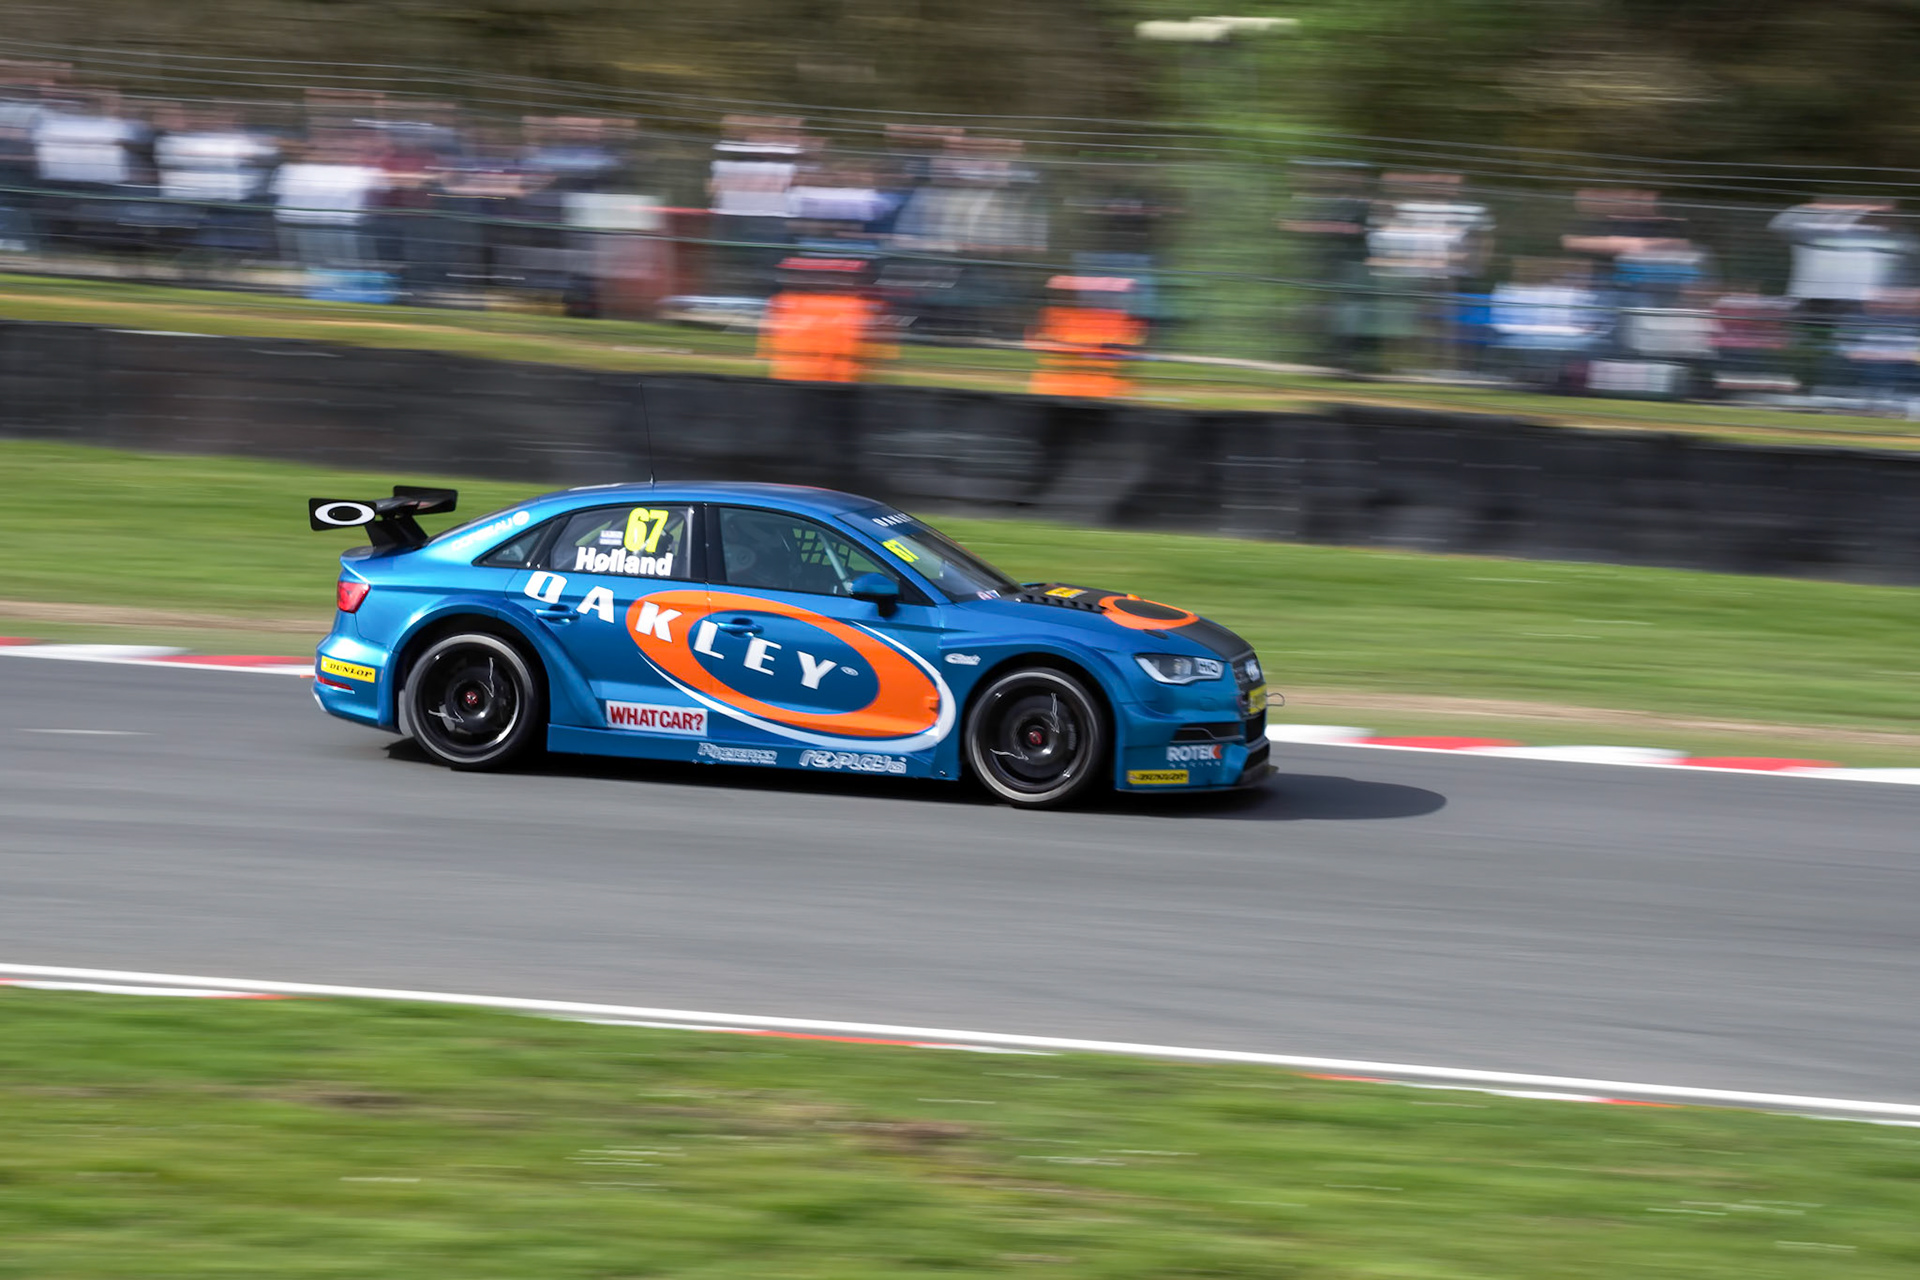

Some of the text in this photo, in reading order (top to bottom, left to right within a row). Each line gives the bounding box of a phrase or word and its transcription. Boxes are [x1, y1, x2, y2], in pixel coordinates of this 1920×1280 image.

[624, 507, 669, 553] 67
[573, 546, 674, 577] Holland
[881, 539, 920, 563] 67
[523, 571, 837, 690] OAKLEY
[329, 662, 373, 678] DUNLOP
